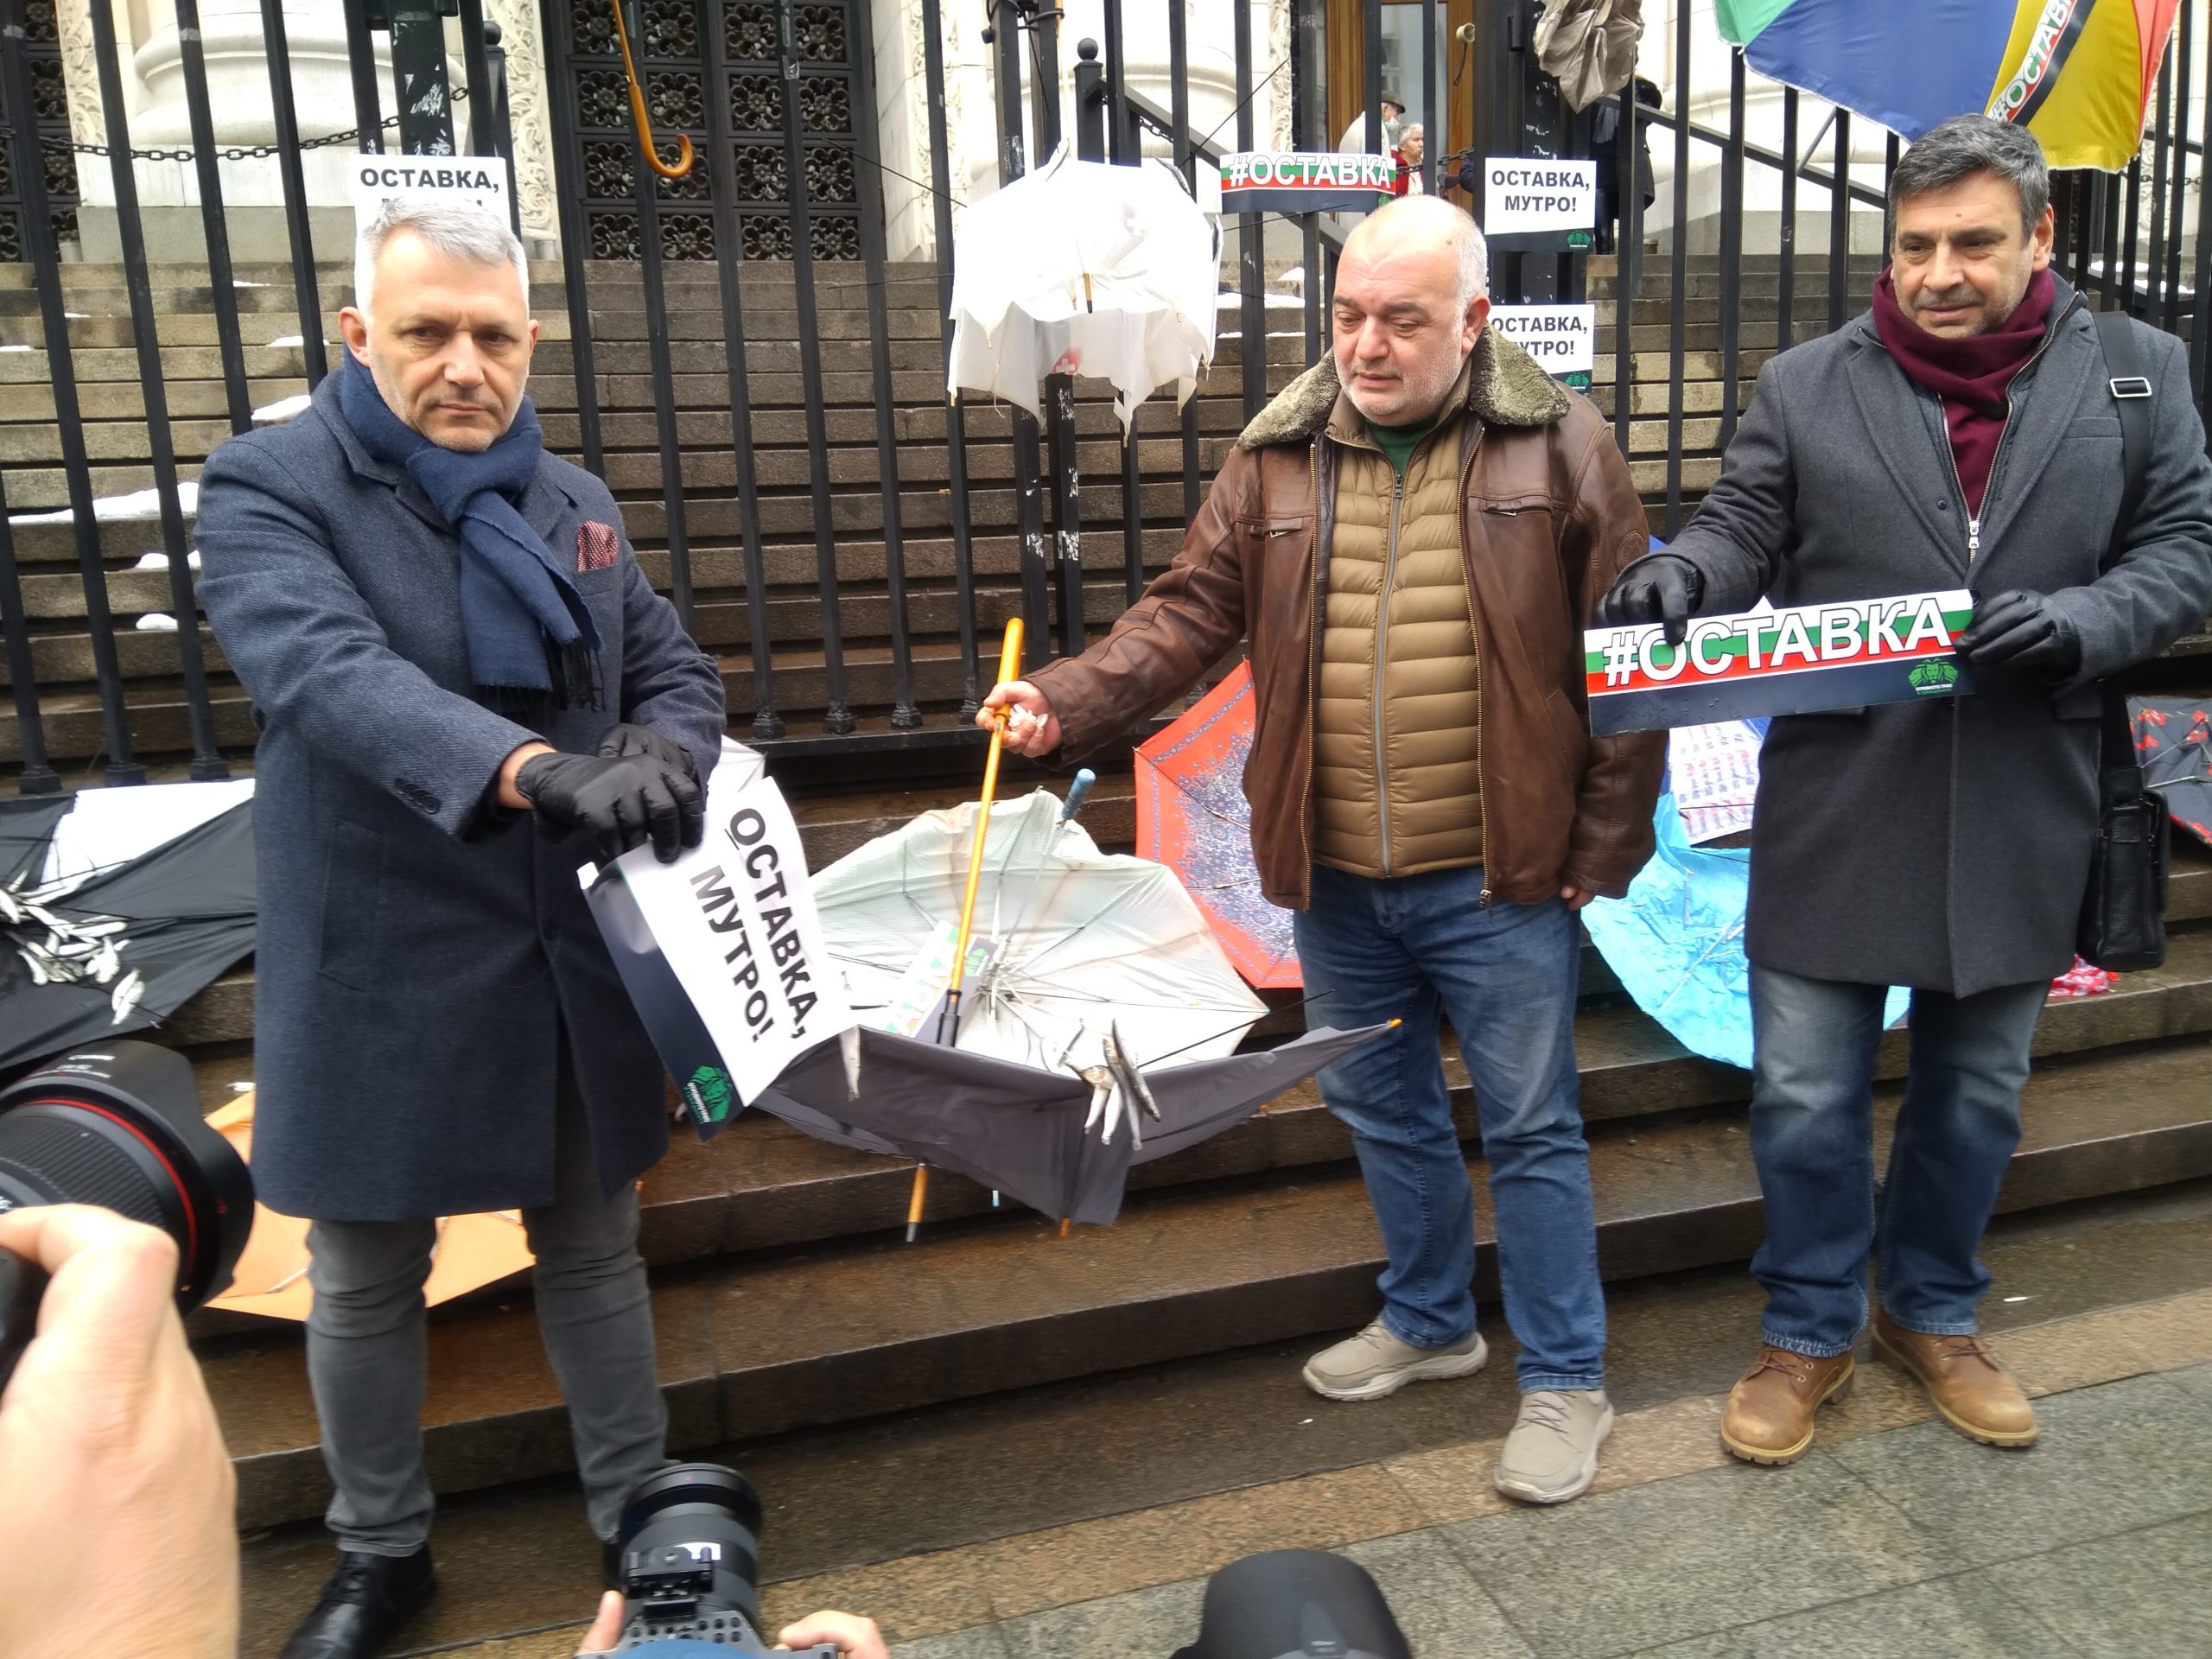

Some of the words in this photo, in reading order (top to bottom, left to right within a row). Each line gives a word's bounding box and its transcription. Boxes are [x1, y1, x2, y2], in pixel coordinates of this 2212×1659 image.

[1991, 0, 2073, 122] #ОСТАВ
[360, 168, 499, 194] ОСТАВКА,
[1229, 155, 1391, 189] #ОСТАВКА
[1491, 169, 1590, 191] ОСТАВКА,
[1504, 195, 1577, 213] МУТРО!
[1491, 316, 1588, 334] ОСТАВКА,
[1516, 340, 1574, 356] УТРО!
[1603, 597, 1954, 688] #ОСТАВКА
[729, 807, 818, 1039] ОСТАВКА,
[689, 864, 774, 1044] МУТРО!
